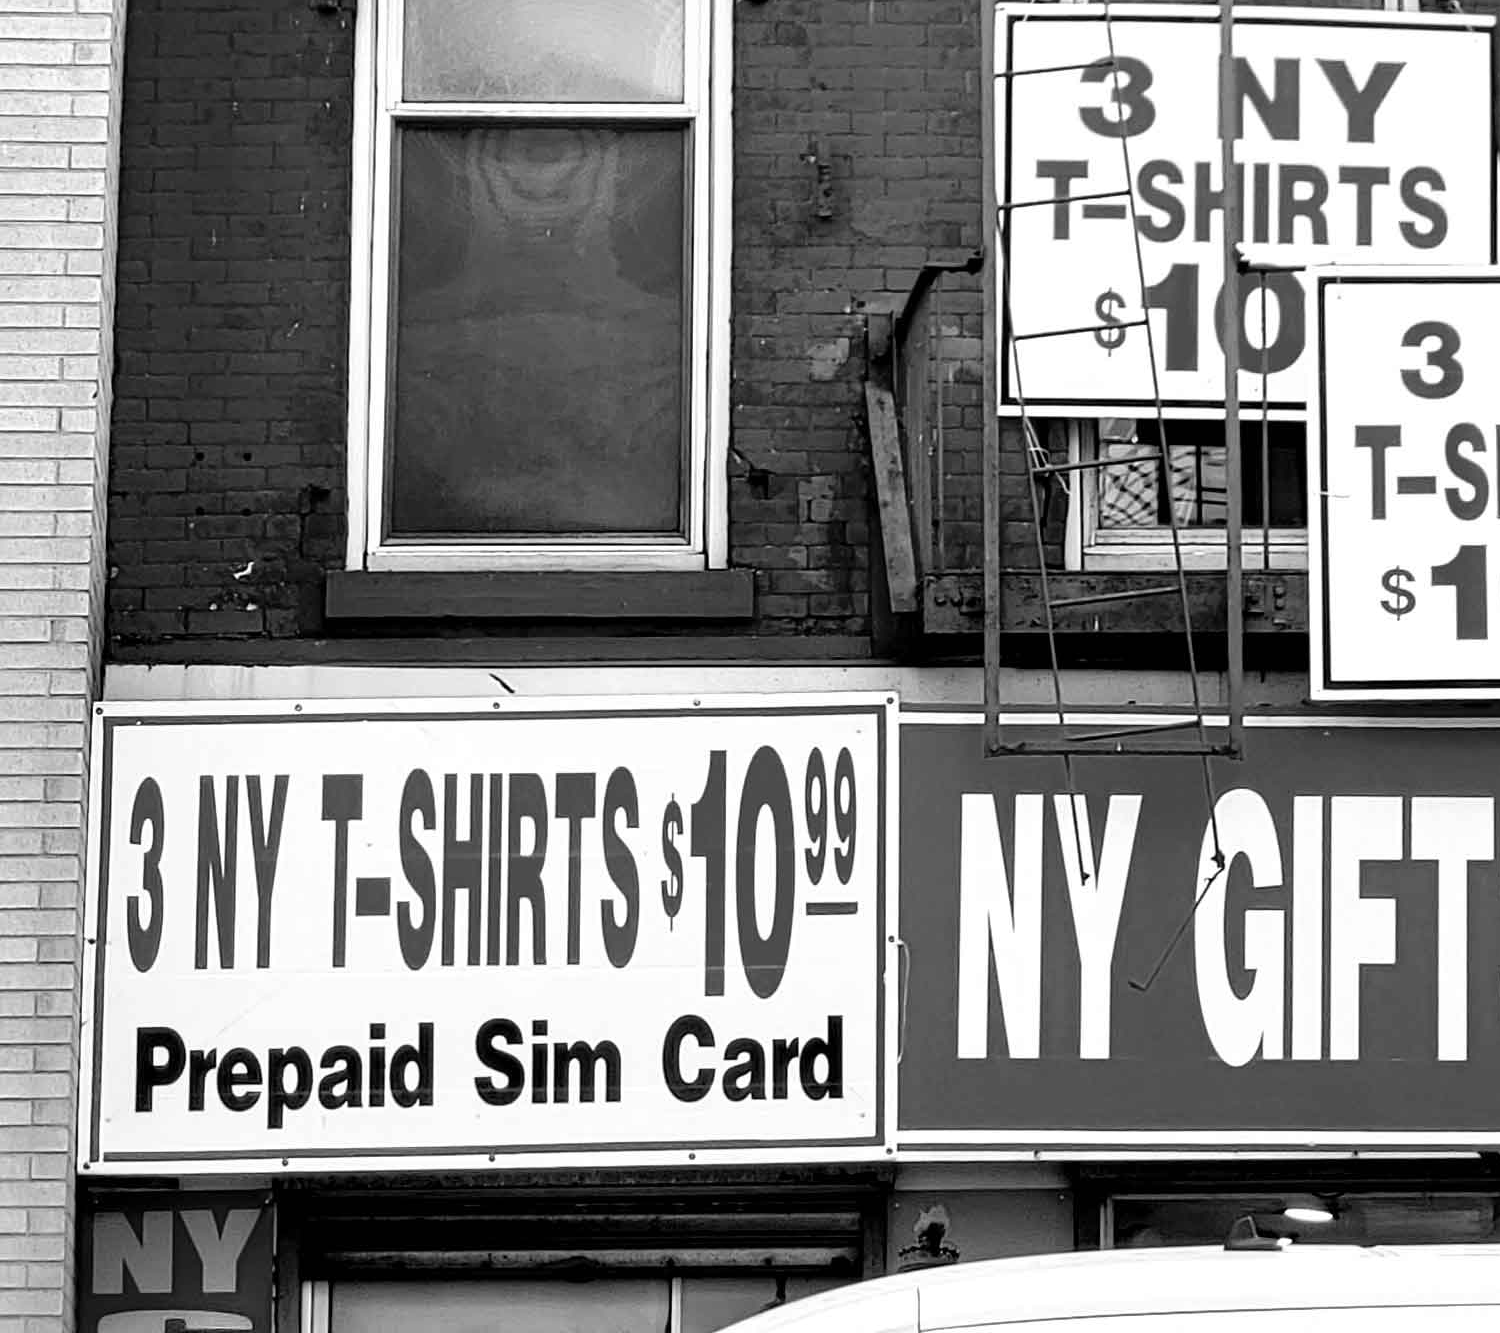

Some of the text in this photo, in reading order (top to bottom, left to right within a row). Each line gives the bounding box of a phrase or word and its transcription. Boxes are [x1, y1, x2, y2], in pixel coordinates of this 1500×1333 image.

[1078, 56, 1407, 143] 3 NY
[1035, 159, 1449, 249] T-SHIRTS
[1400, 320, 1464, 400] 3
[126, 776, 165, 974] 3
[194, 774, 291, 971] NY
[321, 766, 640, 971] T-SHIRTS
[957, 793, 1143, 1060] NY
[134, 1014, 845, 1130] Prepaid Sim Card
[91, 1208, 262, 1295] NY
